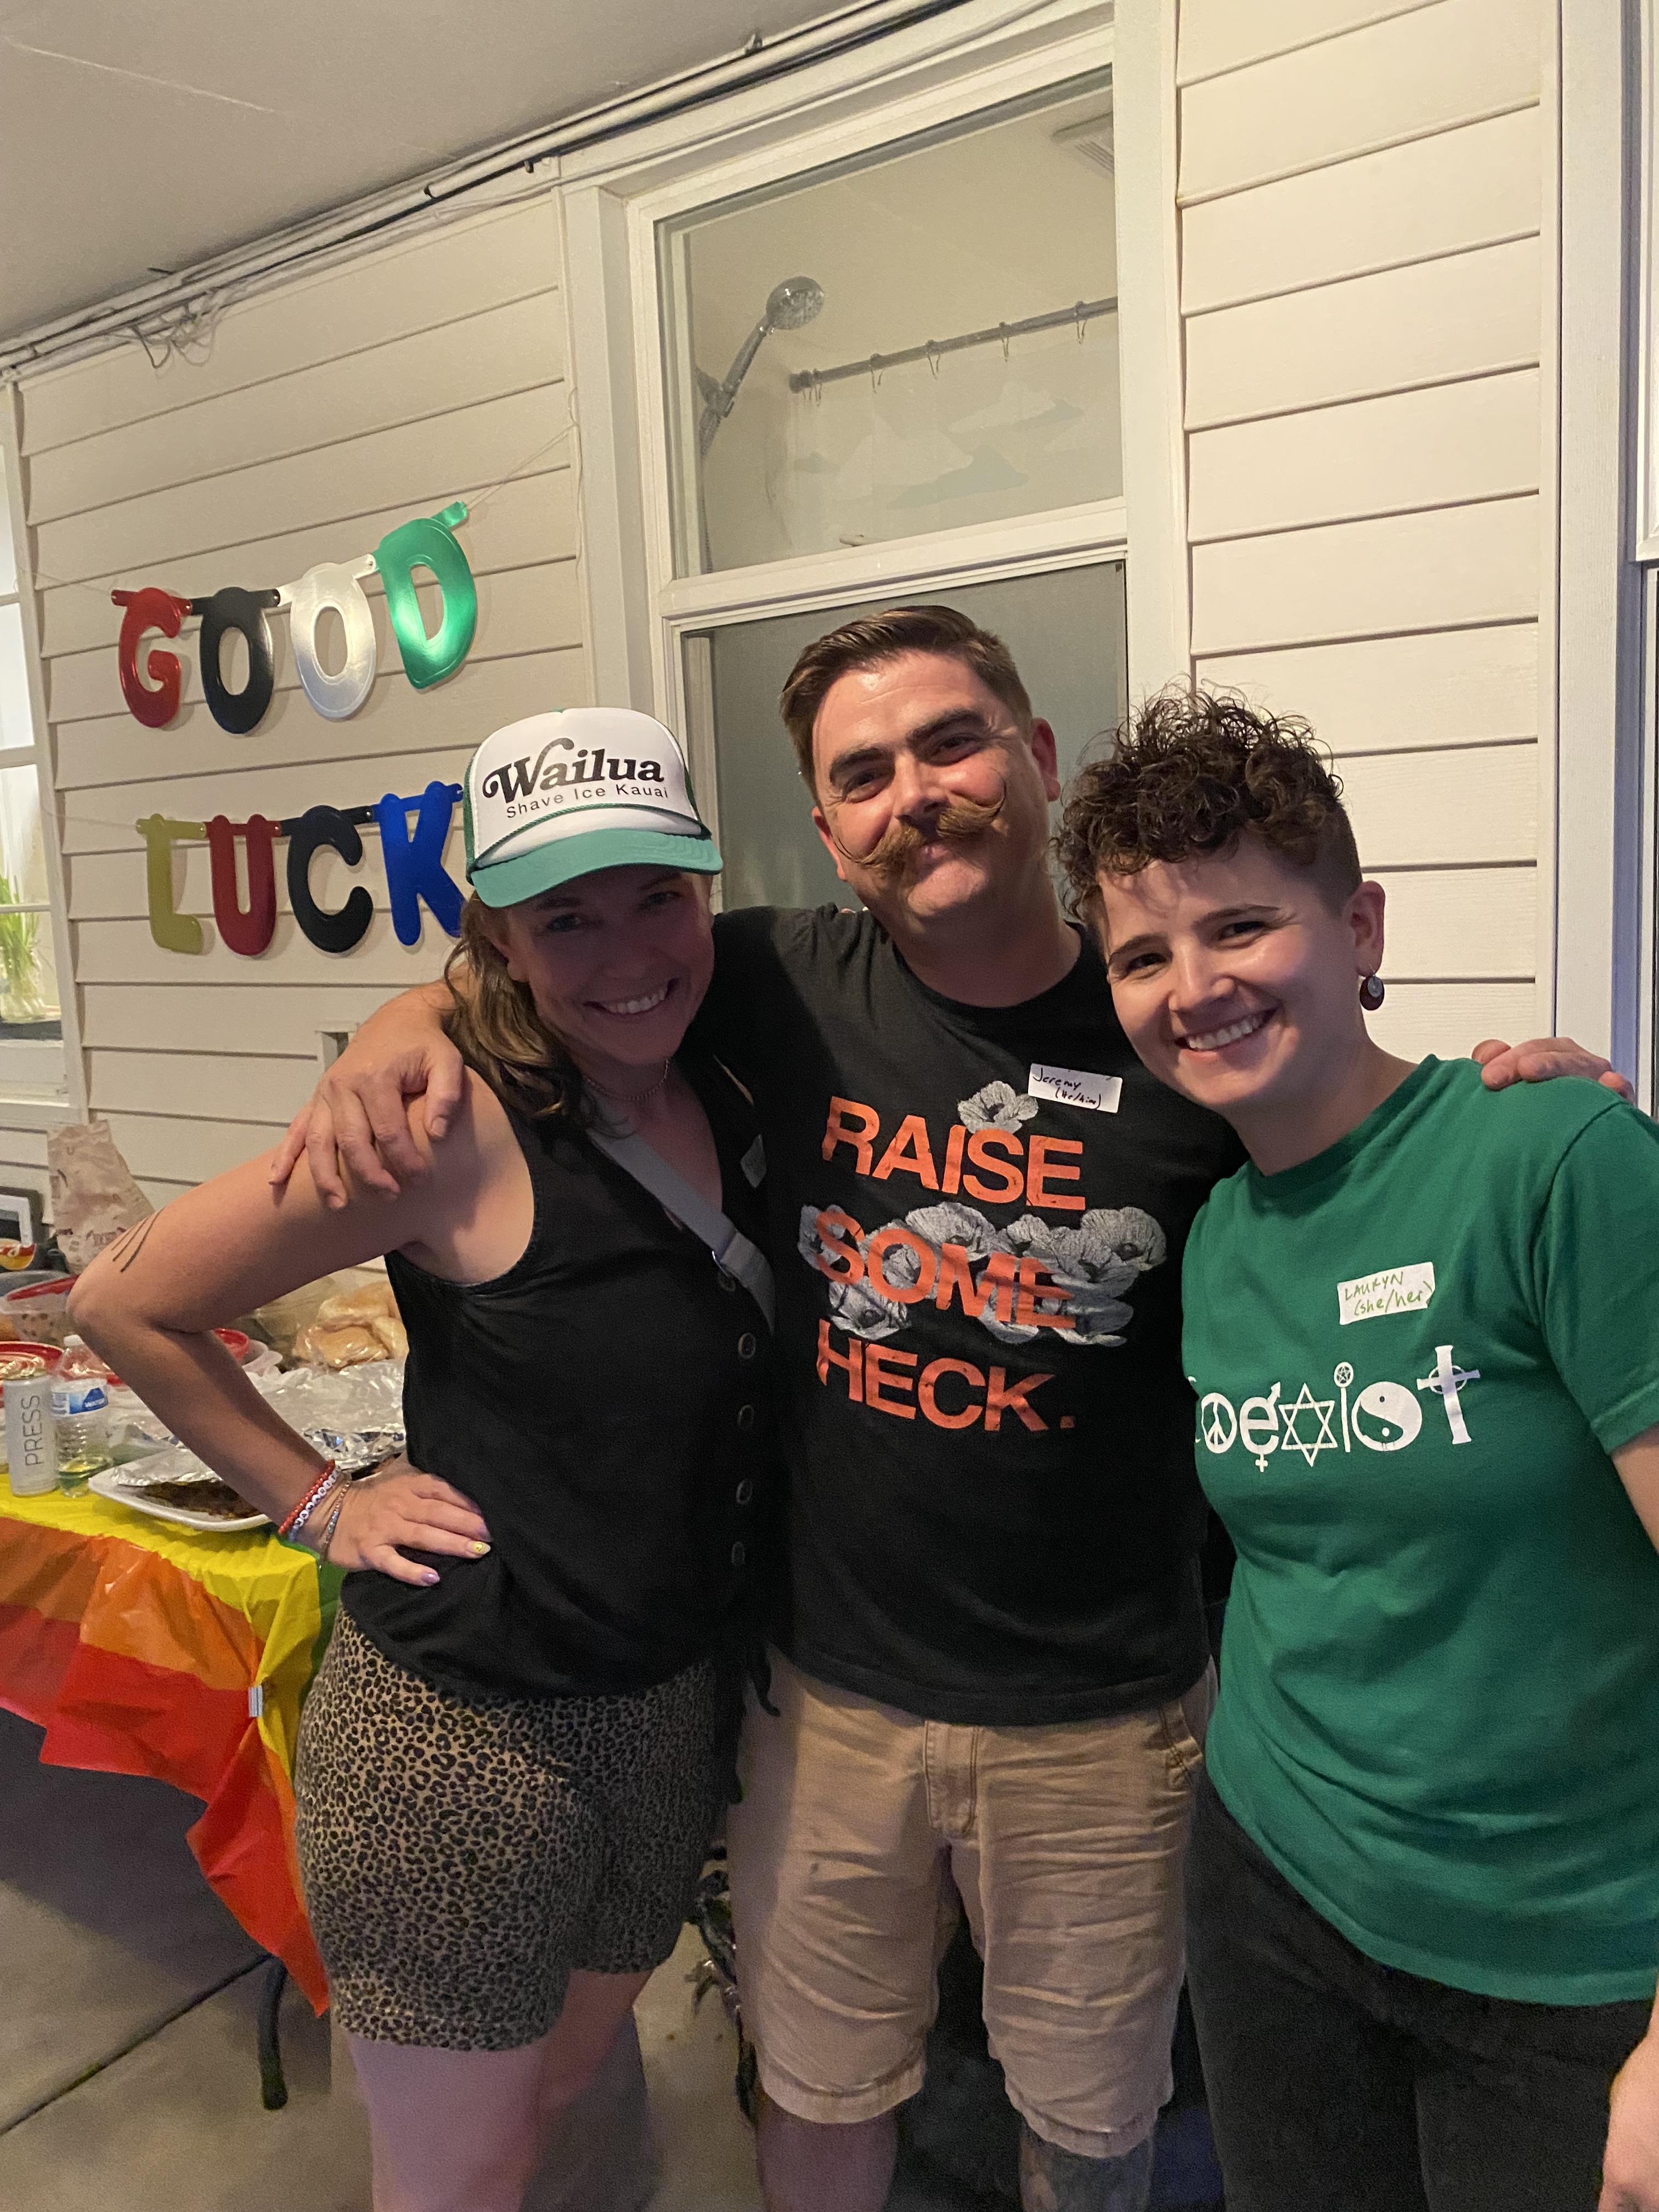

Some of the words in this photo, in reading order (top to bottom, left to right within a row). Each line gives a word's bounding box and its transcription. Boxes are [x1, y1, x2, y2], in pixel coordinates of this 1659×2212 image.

[113, 509, 478, 735] GOOD
[482, 737, 664, 804] Wailua
[506, 792, 564, 819] Shave
[574, 787, 606, 800] Ice
[616, 784, 668, 799] Kauai
[144, 780, 466, 955] LUCK
[1032, 1067, 1081, 1091] Jeremy
[822, 1096, 1086, 1210] RAISE
[815, 1210, 1076, 1329] SOME
[20, 1395, 44, 1466] PRESS
[816, 1318, 1075, 1432] HECK.
